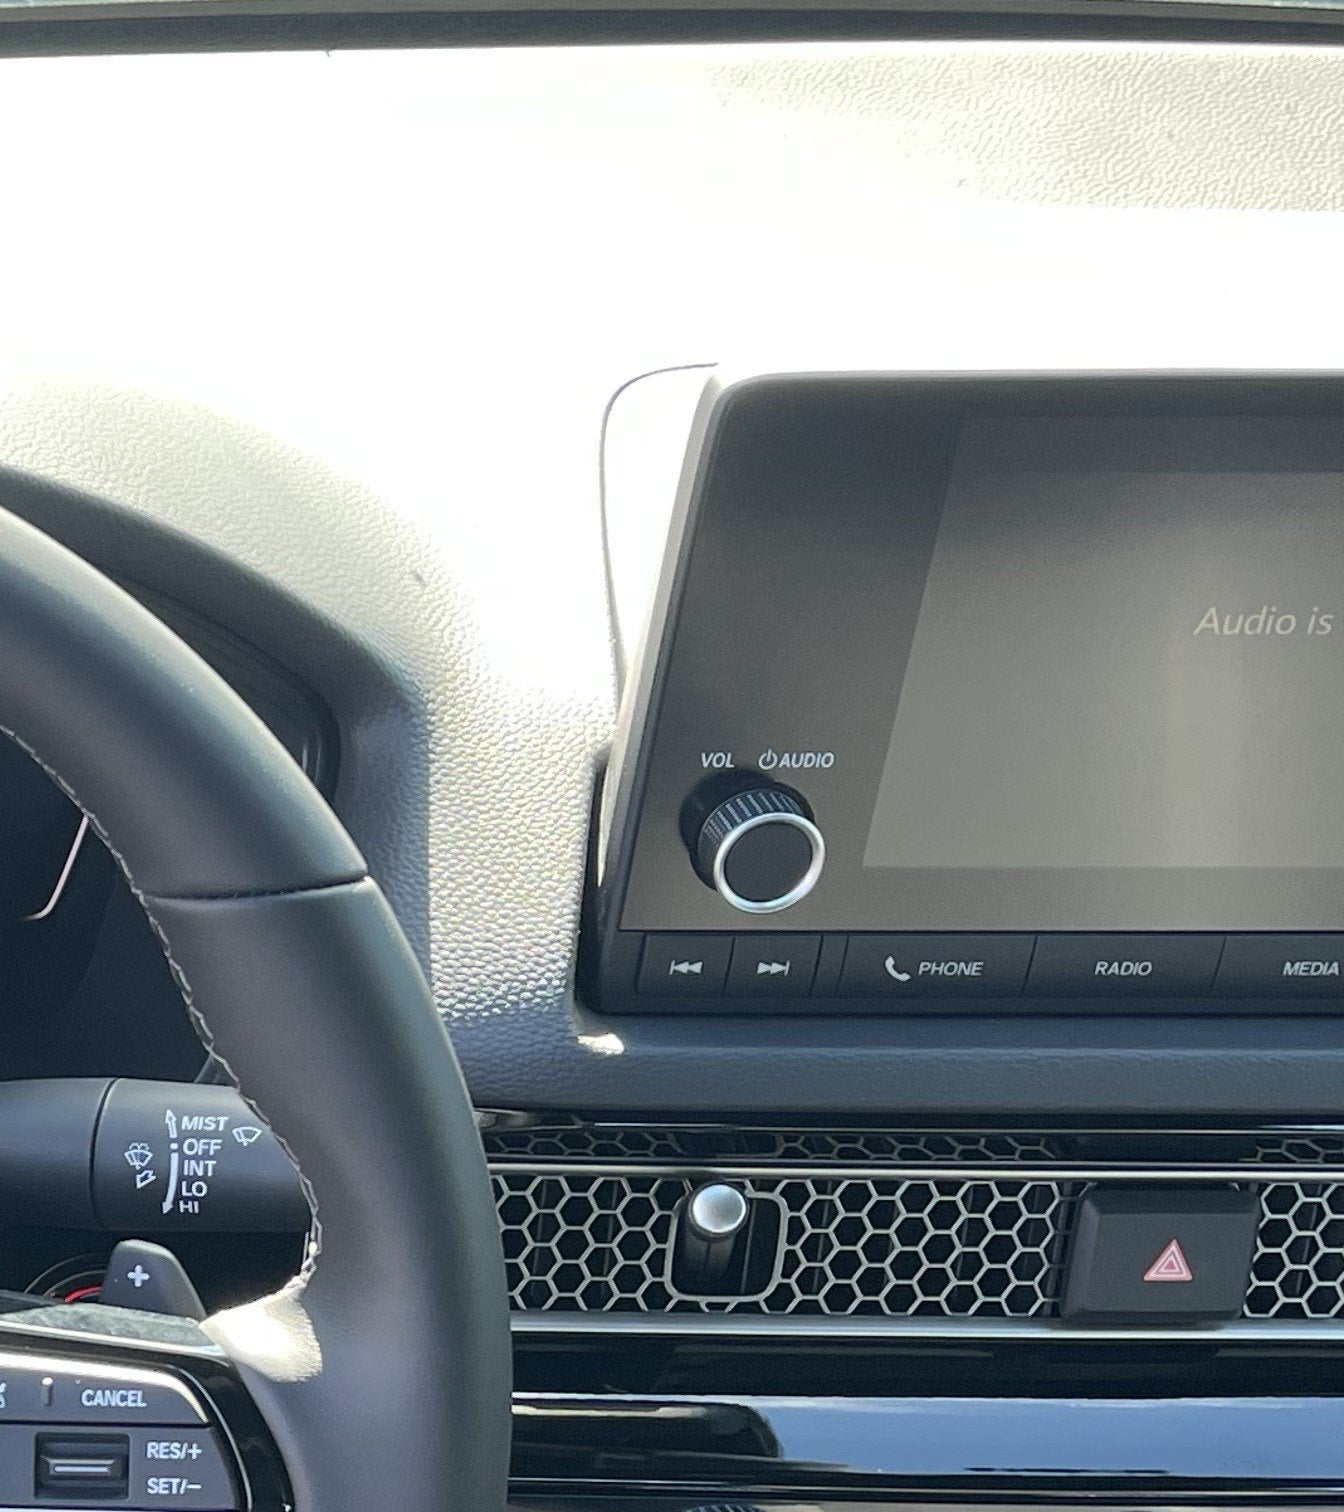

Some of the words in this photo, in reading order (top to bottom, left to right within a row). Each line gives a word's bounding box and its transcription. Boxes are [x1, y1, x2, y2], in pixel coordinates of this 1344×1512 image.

[1193, 606, 1297, 637] Audio
[1306, 606, 1335, 637] is
[700, 751, 735, 769] VOL
[779, 751, 835, 769] AUDIO
[918, 959, 985, 978] PHONE
[1094, 959, 1153, 978] RADIO
[1282, 959, 1342, 978] MEDIA
[181, 1115, 230, 1131] MIST
[182, 1138, 223, 1156] OFF
[183, 1160, 217, 1177] INT
[181, 1180, 208, 1197] LO
[178, 1200, 199, 1214] HI
[80, 1388, 148, 1407] CANCEL
[146, 1441, 202, 1460] RES/+
